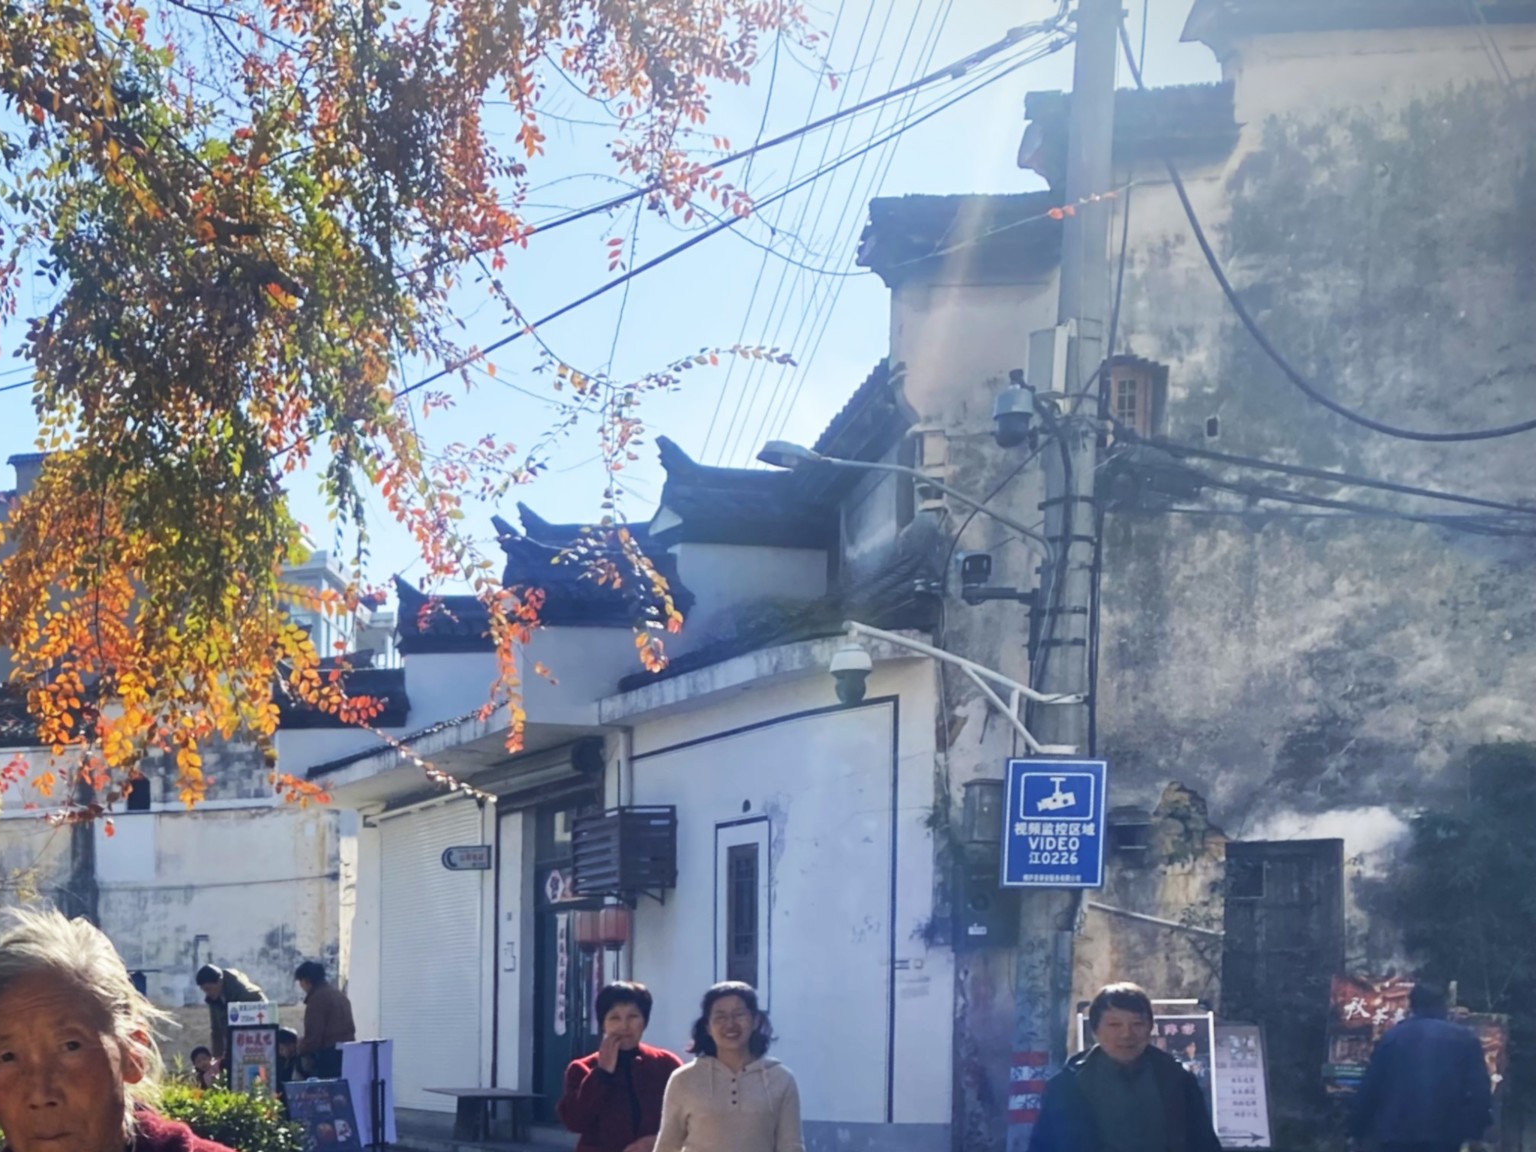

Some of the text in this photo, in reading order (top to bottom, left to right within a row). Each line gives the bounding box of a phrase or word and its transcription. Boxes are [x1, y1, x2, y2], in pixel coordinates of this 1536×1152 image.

[1014, 822, 1095, 836] 视频监控区域
[1028, 836, 1080, 850] VIDEO
[1028, 852, 1078, 865] 江0226
